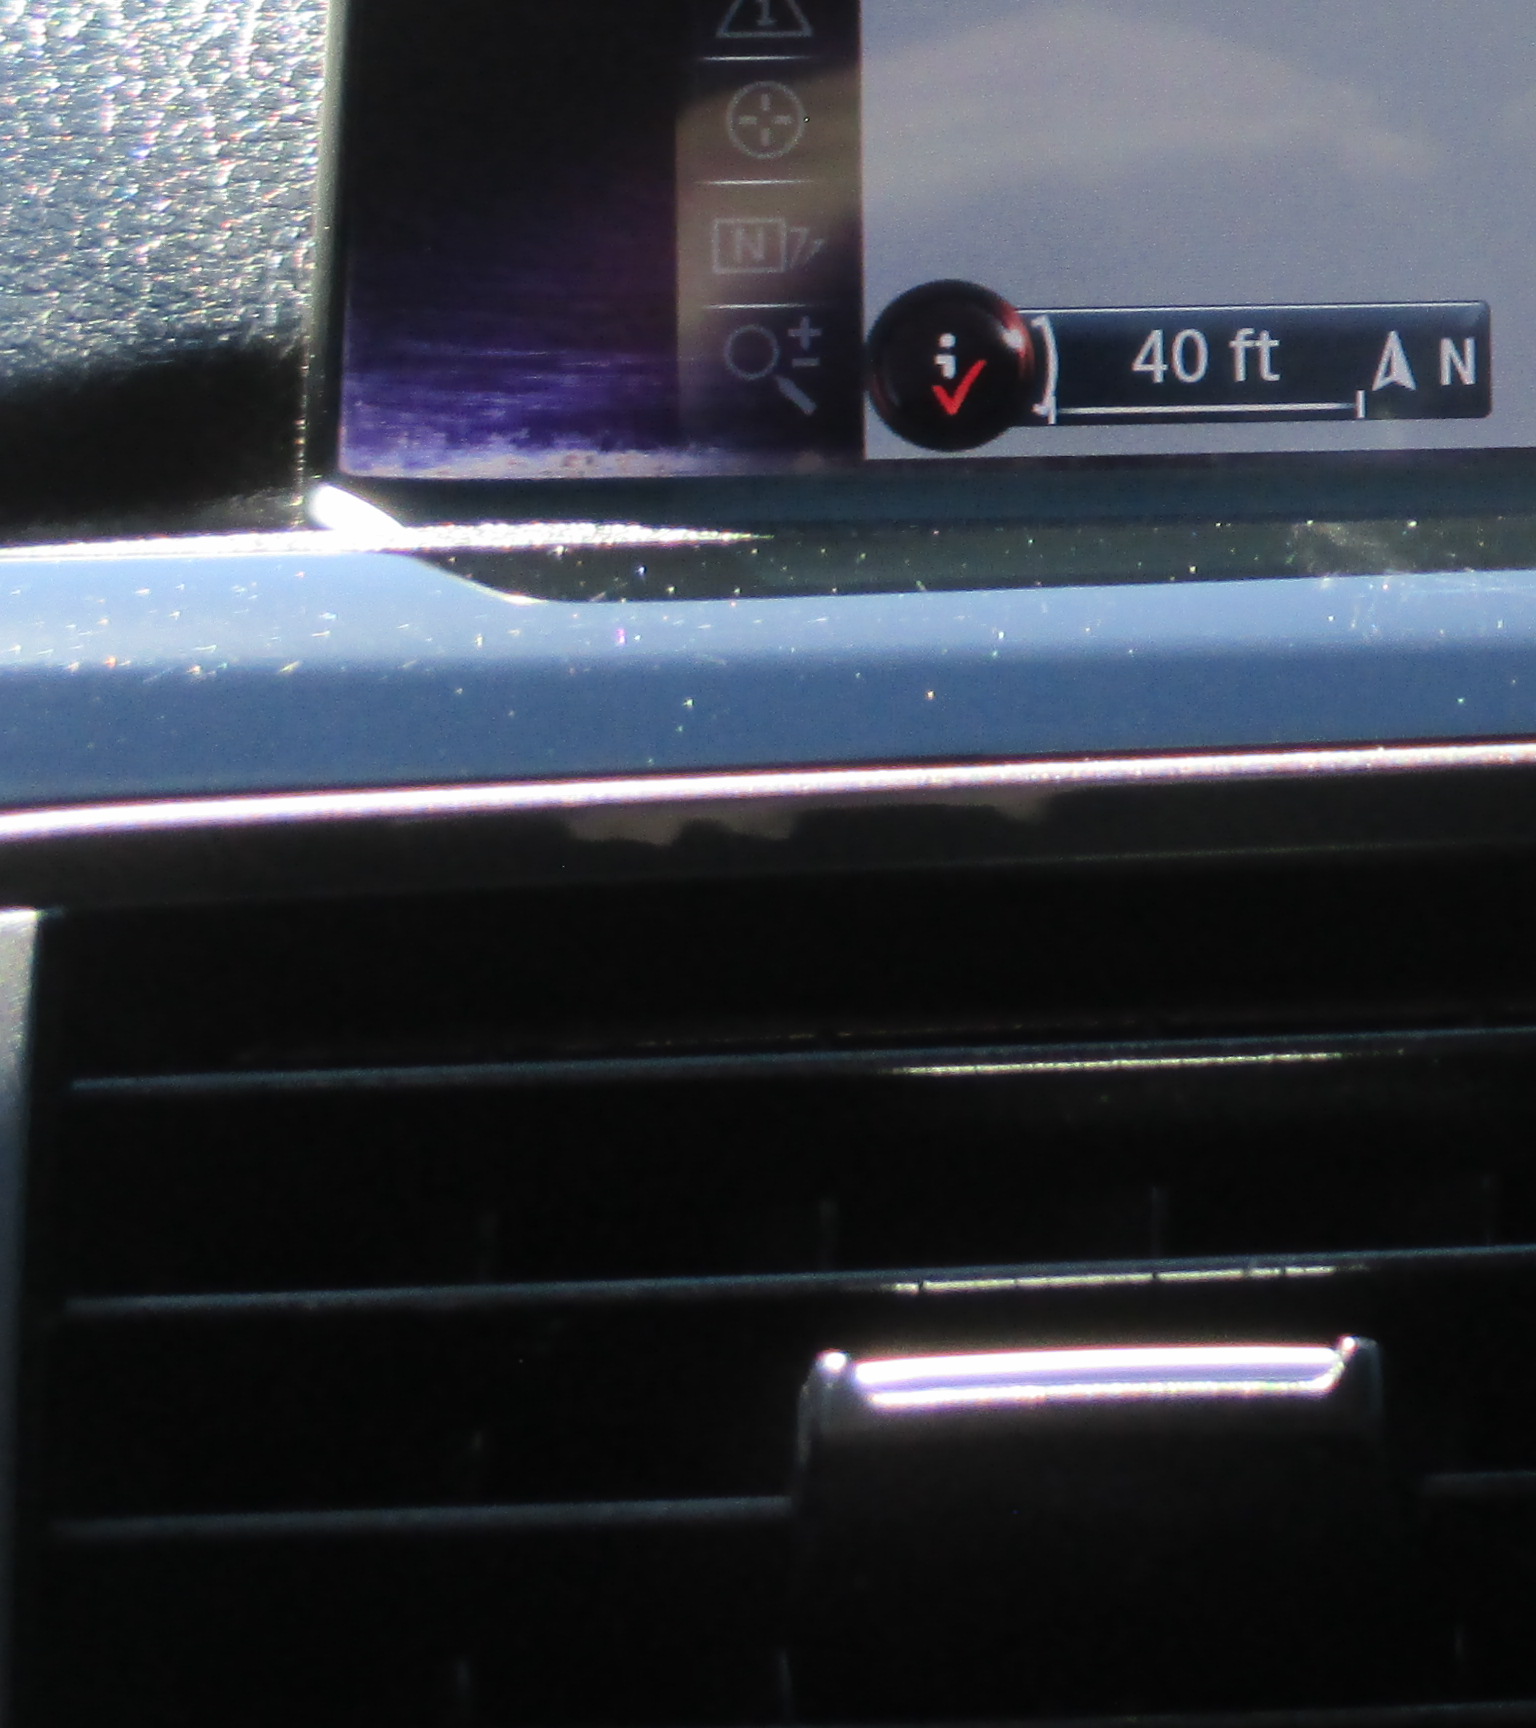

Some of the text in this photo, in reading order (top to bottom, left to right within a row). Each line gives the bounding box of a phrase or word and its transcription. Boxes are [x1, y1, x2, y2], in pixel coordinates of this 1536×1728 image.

[1132, 326, 1281, 384] 40 ft
[1439, 336, 1477, 387] N
